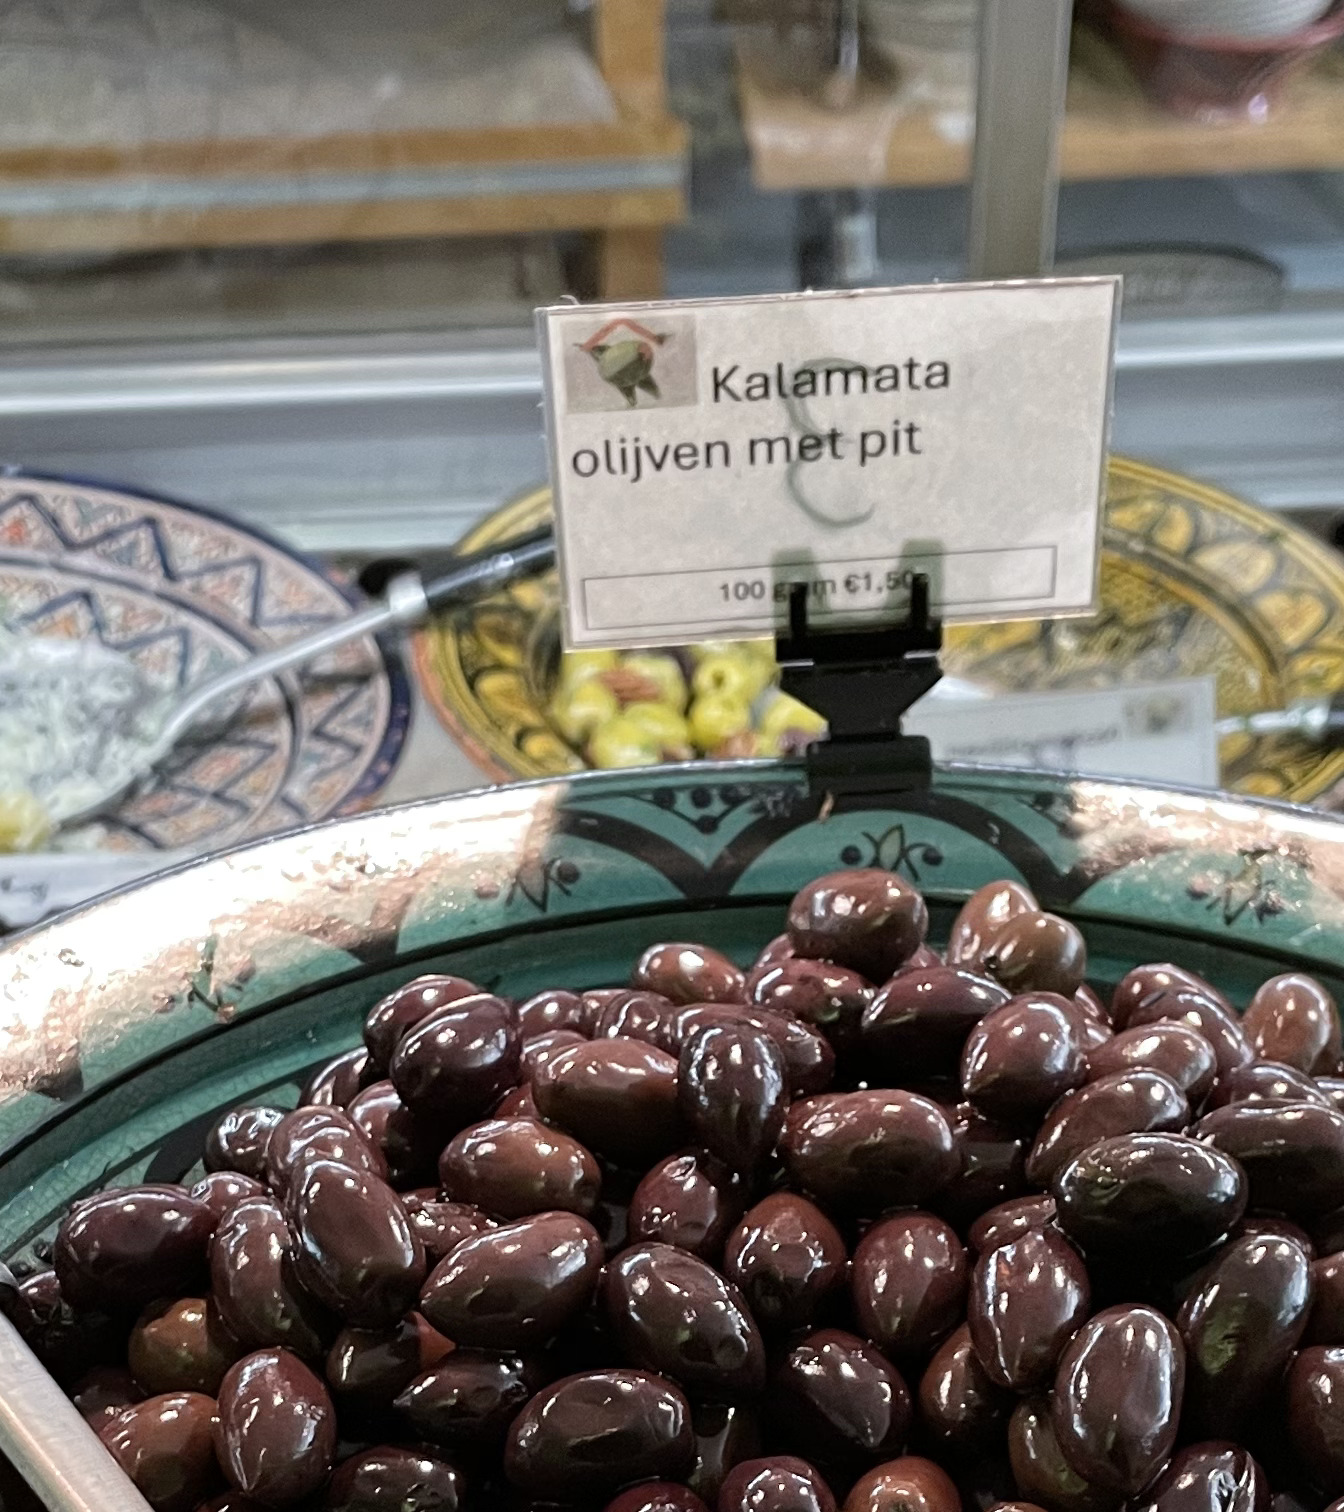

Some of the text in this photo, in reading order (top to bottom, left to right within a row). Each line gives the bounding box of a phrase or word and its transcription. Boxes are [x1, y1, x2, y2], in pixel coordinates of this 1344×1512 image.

[711, 355, 951, 403] Kalamata
[572, 420, 923, 483] olijven met pit
[719, 580, 766, 603] 100
[773, 578, 838, 602] gm
